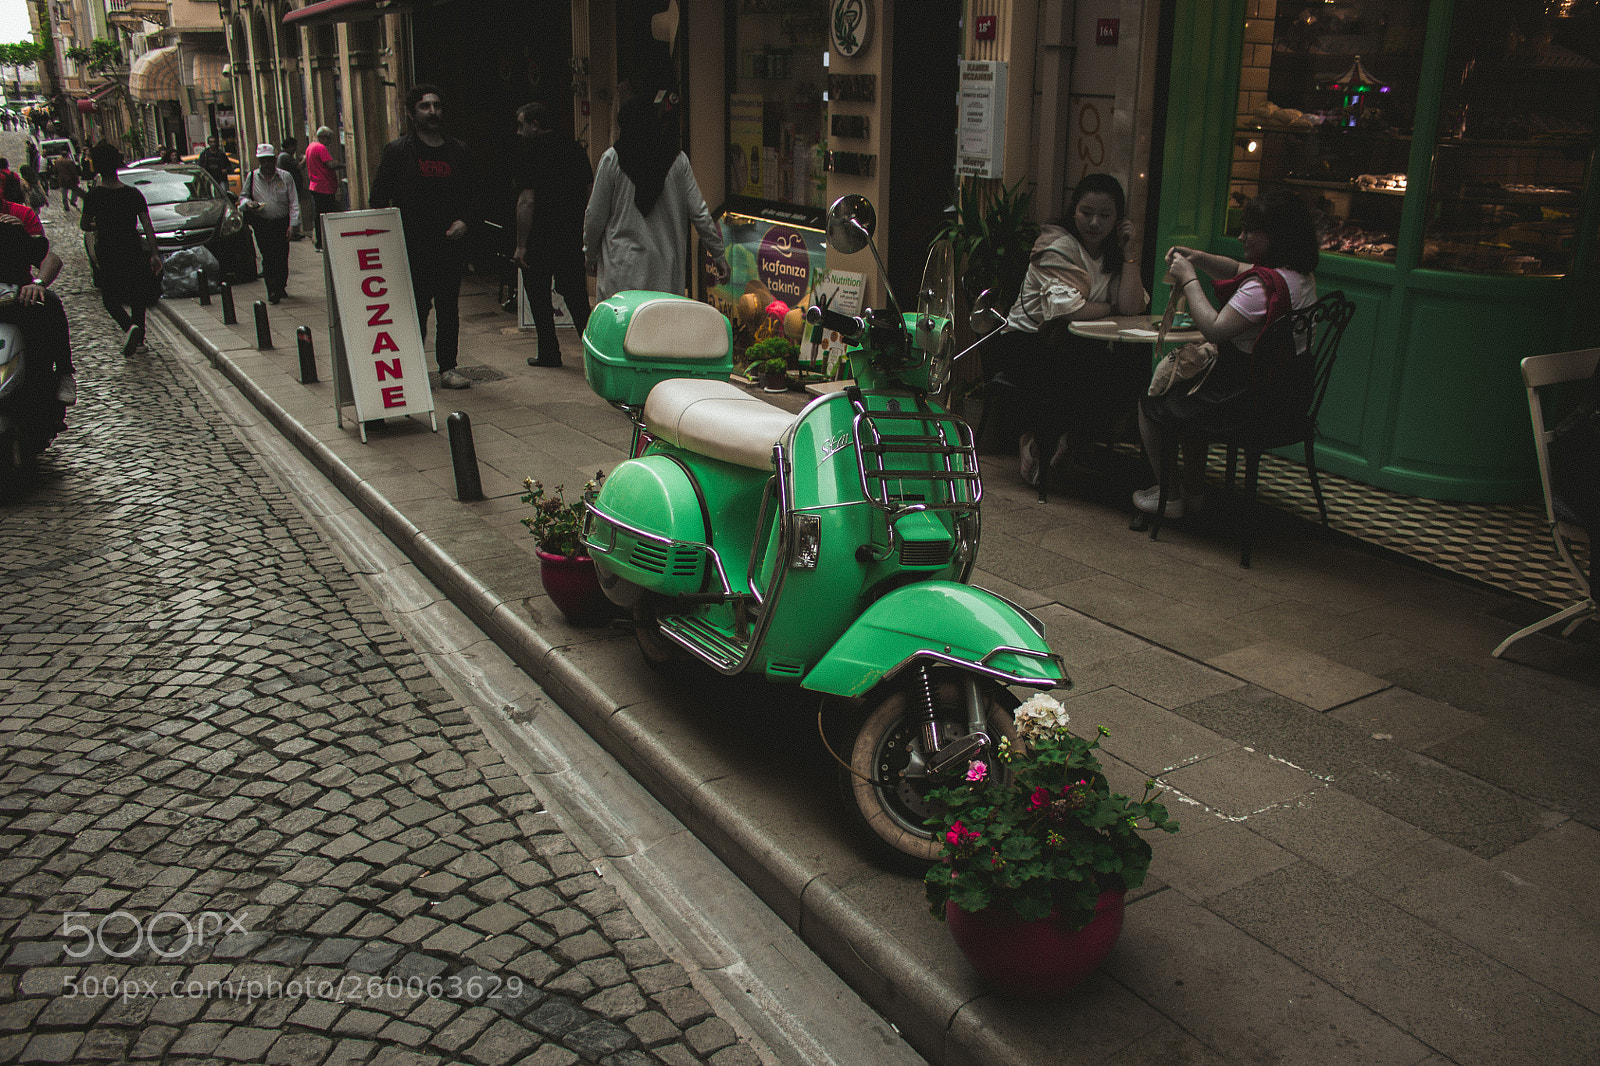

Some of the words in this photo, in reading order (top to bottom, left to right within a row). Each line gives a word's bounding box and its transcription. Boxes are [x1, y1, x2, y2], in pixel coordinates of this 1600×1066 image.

[761, 258, 806, 278] kafanıza
[767, 277, 800, 296] takın'a
[831, 274, 861, 287] Nutrition
[357, 248, 406, 408] ECZANE
